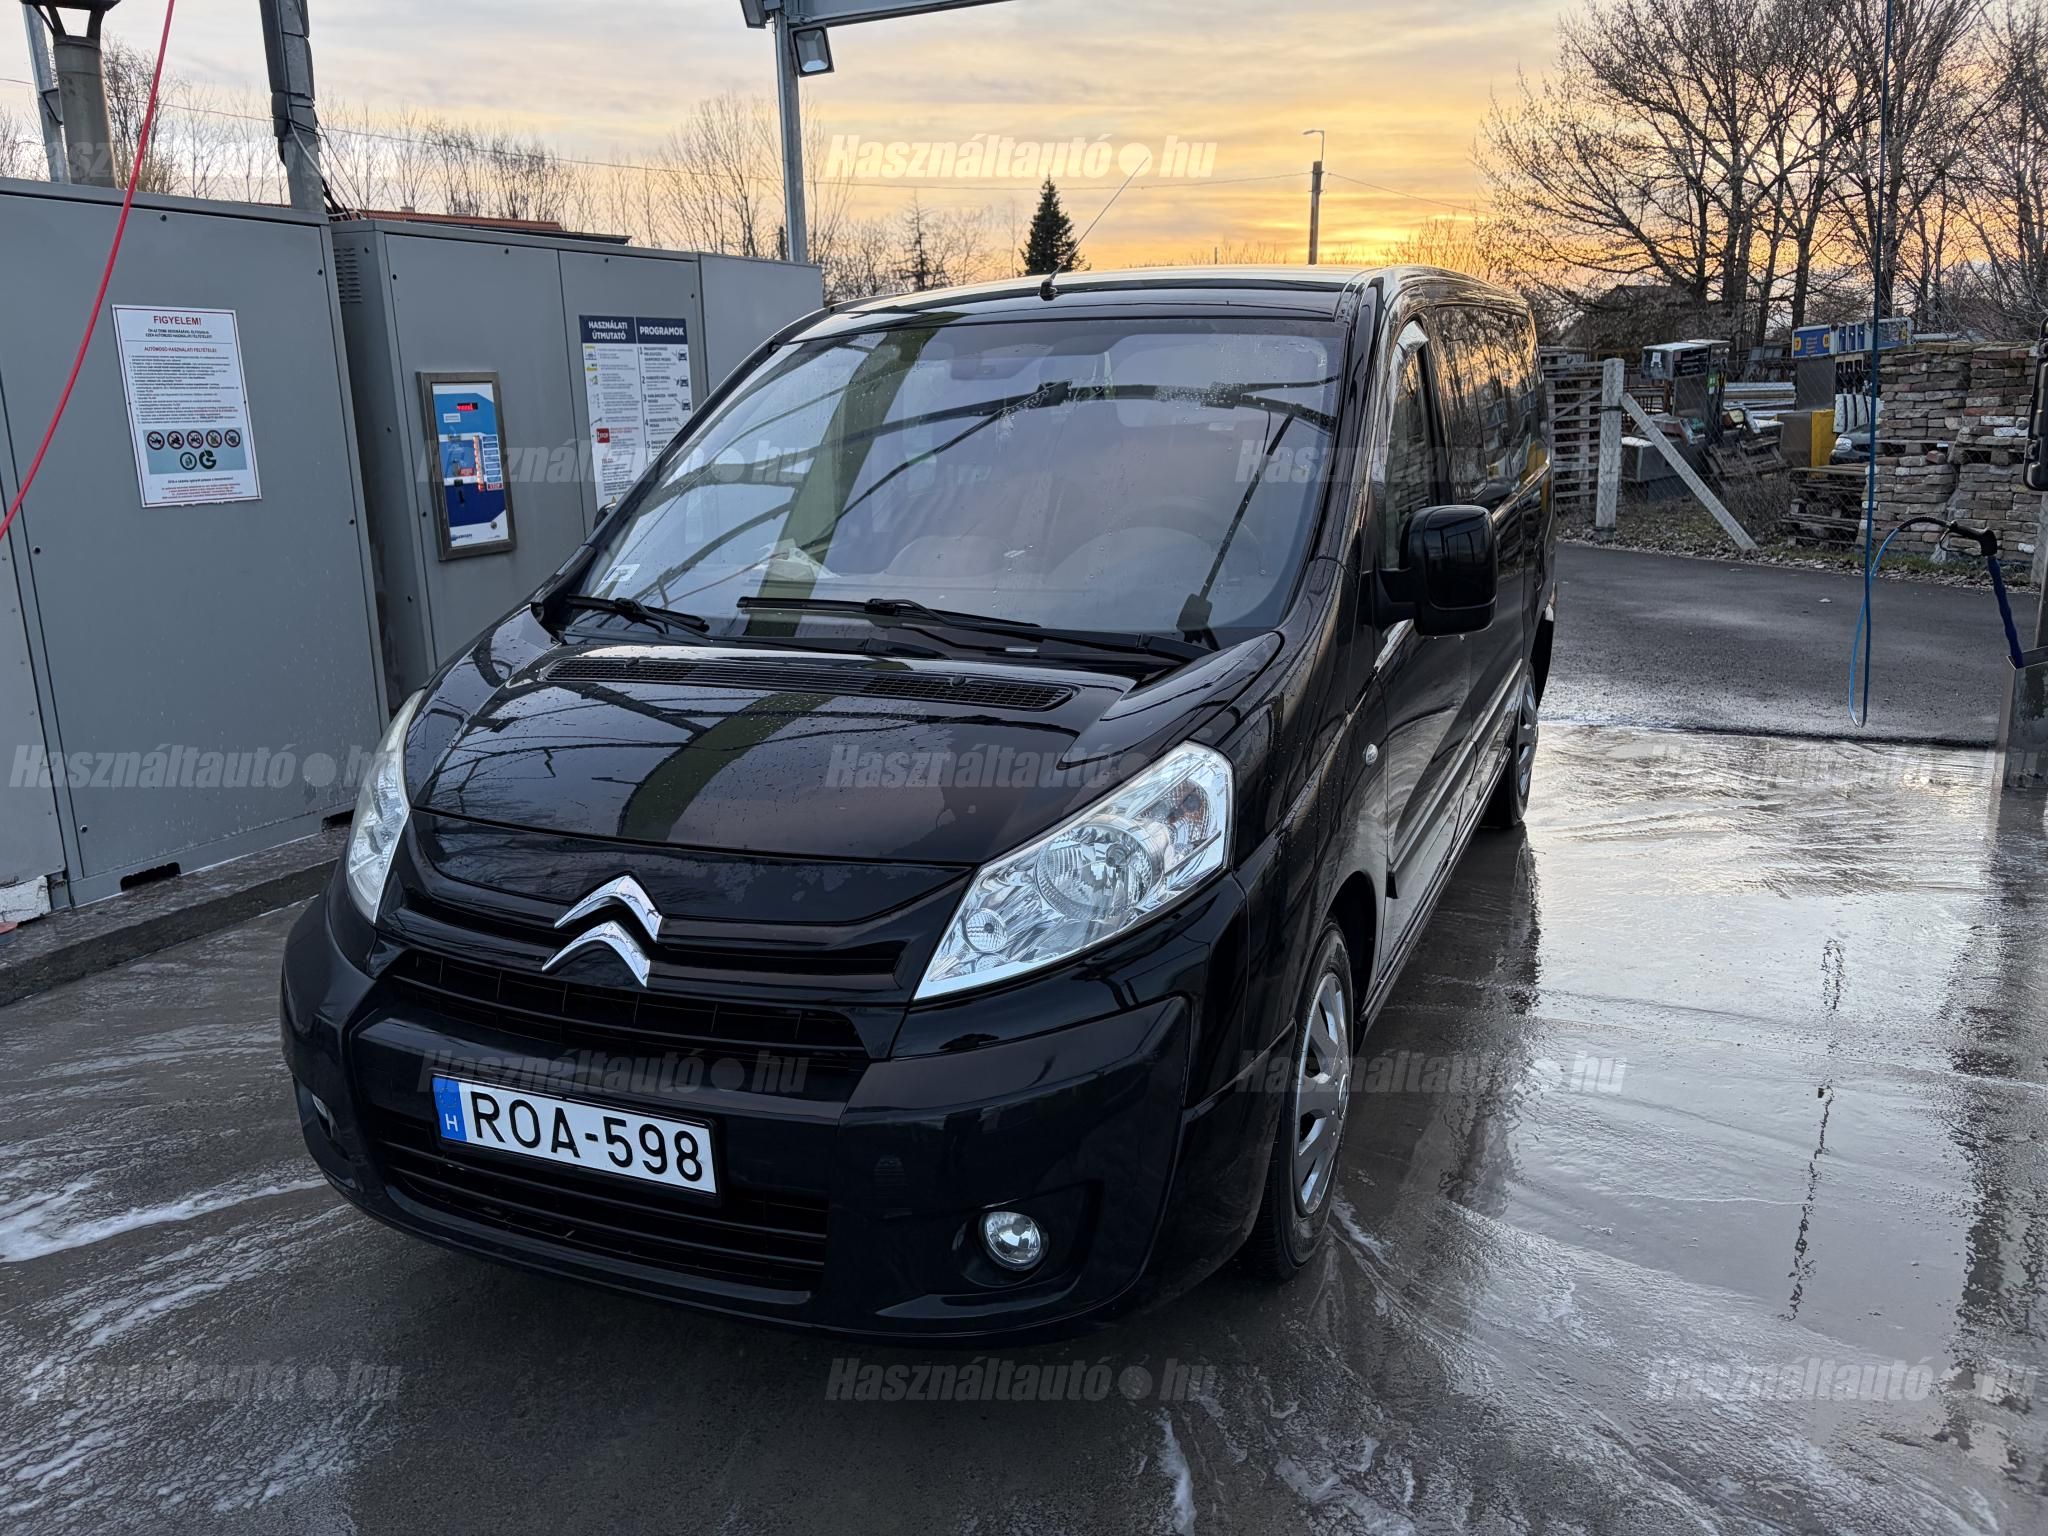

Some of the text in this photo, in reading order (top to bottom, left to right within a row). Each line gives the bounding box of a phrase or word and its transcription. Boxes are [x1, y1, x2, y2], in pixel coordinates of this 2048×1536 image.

[153, 315, 202, 325] FIGYELEM!
[588, 320, 628, 330] HASZNÁLATI
[592, 331, 626, 340] ÚTMUTATÓ
[639, 326, 685, 336] PROGRAMOK
[445, 1113, 458, 1132] H
[470, 1091, 703, 1182] ROA-598
